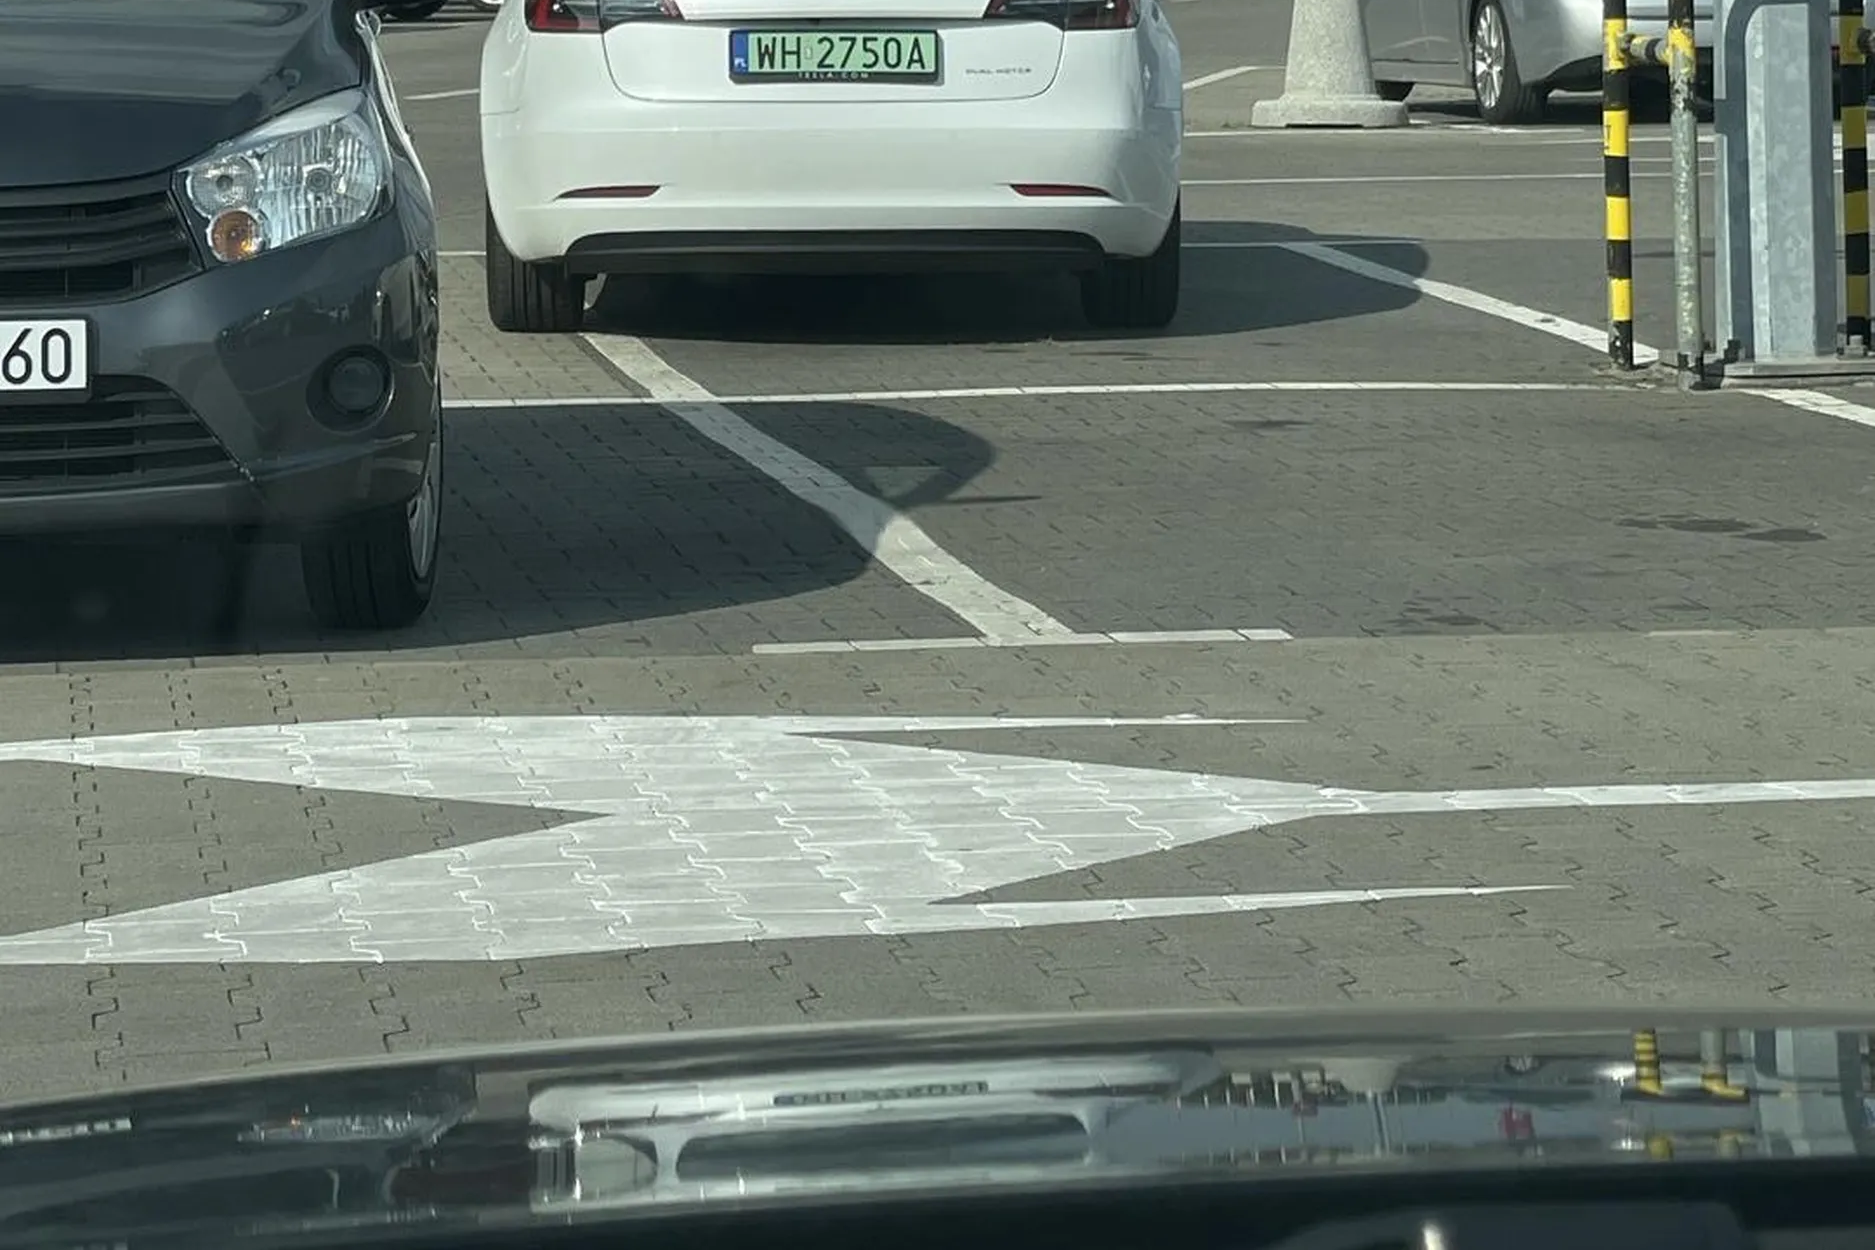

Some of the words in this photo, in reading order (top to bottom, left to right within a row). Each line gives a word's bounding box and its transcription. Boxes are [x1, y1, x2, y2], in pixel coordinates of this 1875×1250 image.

[757, 36, 801, 70] WH
[817, 36, 926, 70] 2750A
[2, 327, 73, 385] 60
